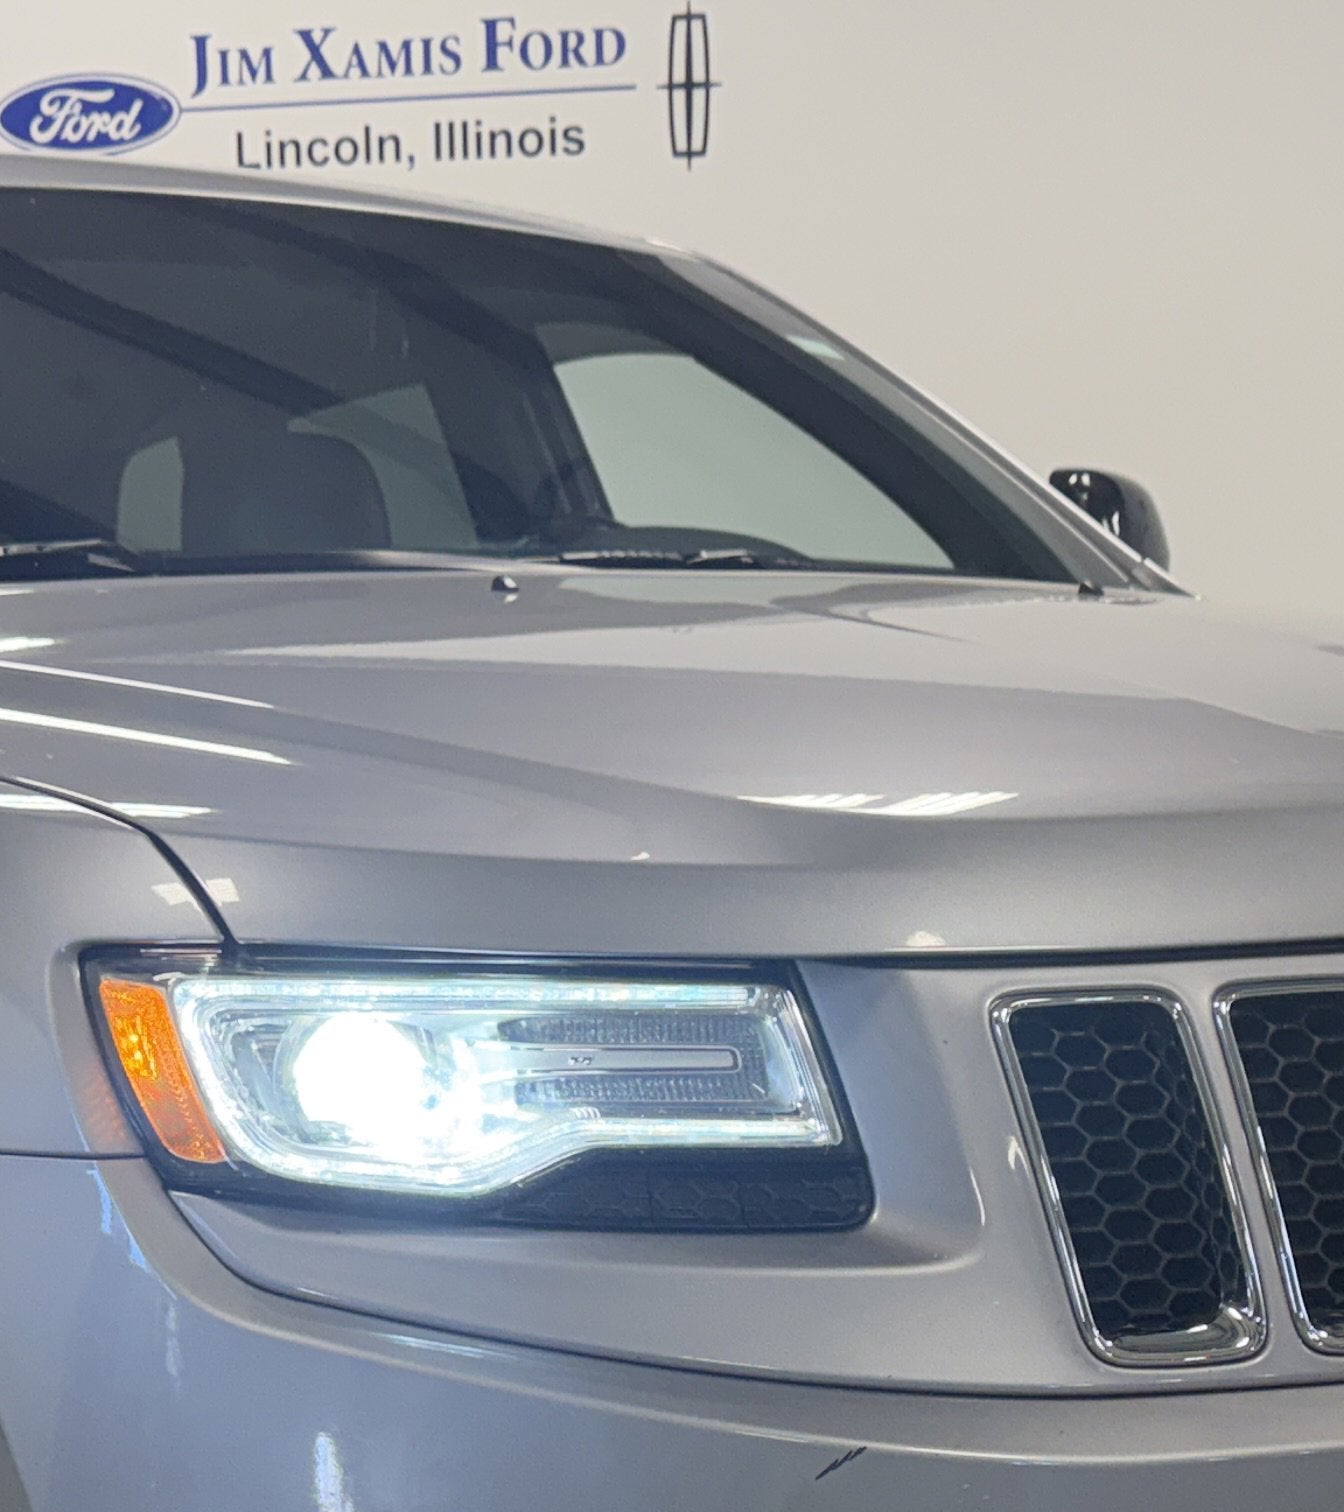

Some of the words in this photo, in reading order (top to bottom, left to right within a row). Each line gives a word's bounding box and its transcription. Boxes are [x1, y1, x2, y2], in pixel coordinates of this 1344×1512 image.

[189, 33, 275, 99] JIM
[293, 26, 463, 84] XAMIS
[479, 16, 627, 74] FORD
[28, 87, 144, 145] Ford
[235, 122, 416, 172] Lincoln,
[433, 115, 586, 163] Illinois
